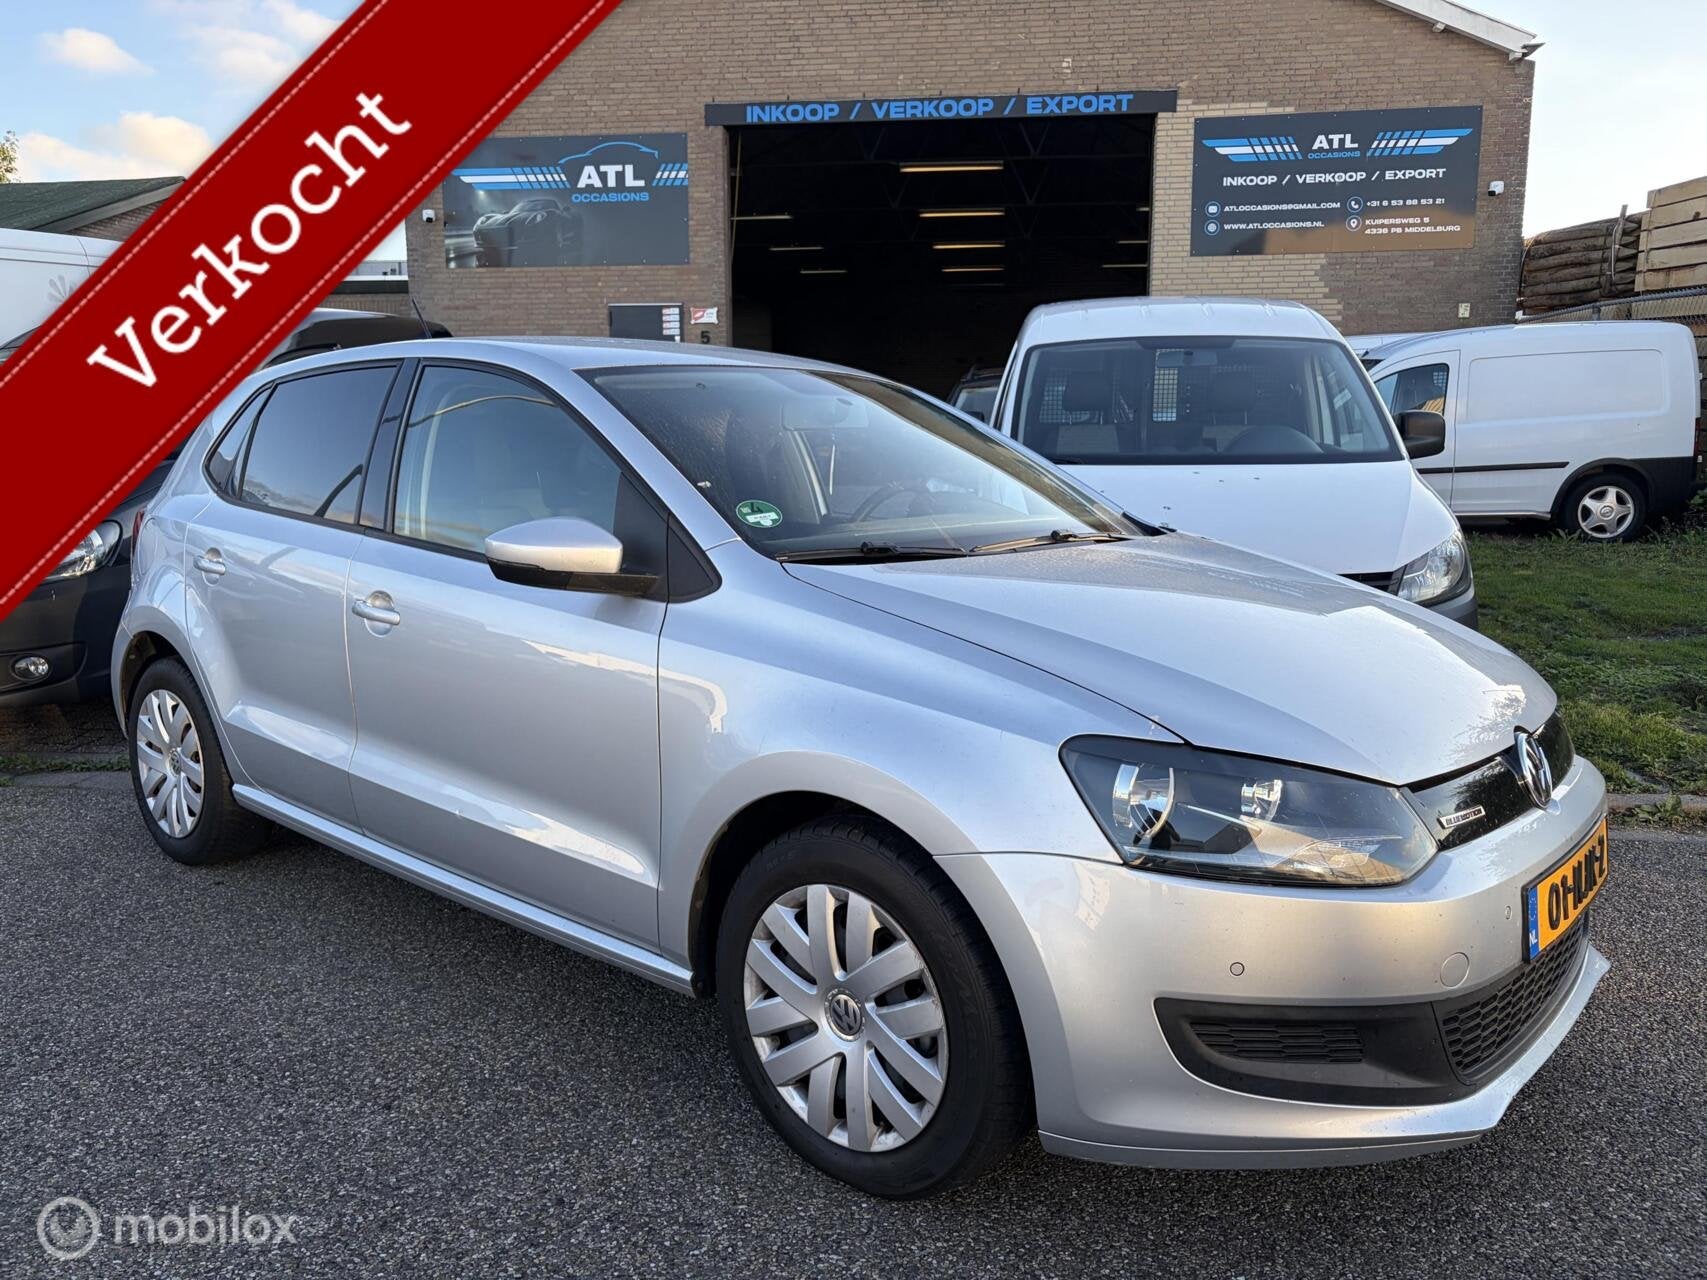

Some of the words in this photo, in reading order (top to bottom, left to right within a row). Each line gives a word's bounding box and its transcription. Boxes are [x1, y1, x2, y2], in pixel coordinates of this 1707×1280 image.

[745, 103, 840, 123] INKOOP
[849, 102, 861, 120] /
[870, 99, 994, 119] VERKOOP
[1003, 97, 1016, 115] /
[1026, 94, 1134, 115] EXPORT
[1312, 134, 1358, 150] ATL
[1307, 150, 1361, 160] OCCASIONS
[577, 164, 645, 188] ATL
[1222, 175, 1278, 187] INKOOP
[1295, 171, 1367, 185] VERKOOP
[1385, 168, 1446, 180] EXPORT
[571, 192, 650, 203] OCCASIONS
[1224, 221, 1325, 230] WWW.ATLOCCASIONS.NL
[1365, 217, 1421, 225] KUIPERSWEG
[1404, 225, 1461, 233] MIDDELBURG
[700, 330, 711, 344] 5
